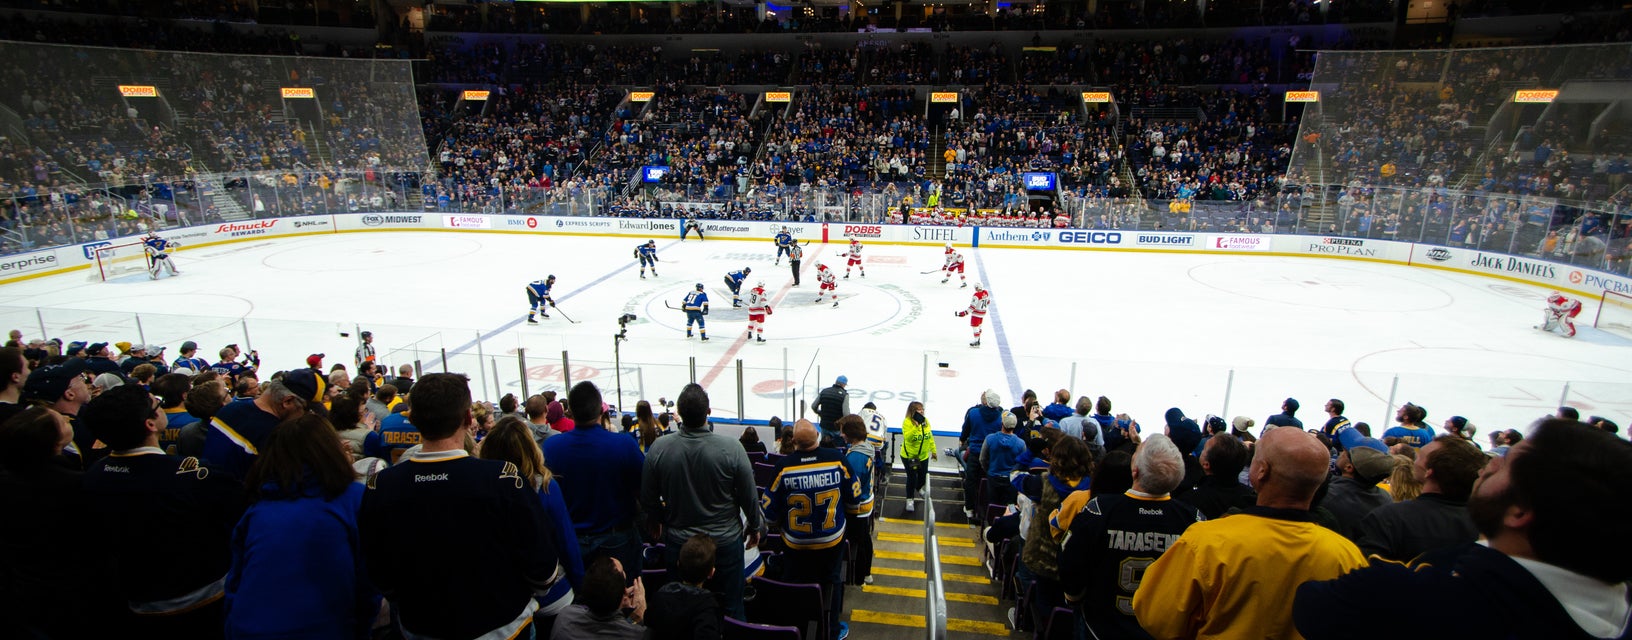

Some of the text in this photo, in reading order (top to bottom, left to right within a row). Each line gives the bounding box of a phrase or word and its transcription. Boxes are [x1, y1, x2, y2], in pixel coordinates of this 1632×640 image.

[385, 215, 422, 223] MIDWEST
[460, 216, 483, 224] FAMOUS
[214, 219, 278, 233] Schnucks
[618, 220, 675, 231] Edward Jones
[706, 224, 750, 232] MOLottery.com
[844, 225, 882, 234] DOBBS
[231, 229, 265, 237] REWARDS
[913, 227, 958, 241] STIFEL
[987, 230, 1029, 242] Anthem
[1058, 231, 1122, 244] GEICO
[1138, 235, 1193, 244] BUD LIGHT
[1229, 237, 1260, 245] FAMOUS
[1330, 238, 1363, 246] PURINA
[1308, 243, 1376, 257] PRO PLAN
[0, 255, 55, 271] erprise
[1471, 252, 1556, 279] JACK DANIEL'S
[687, 295, 697, 304] 91
[870, 414, 882, 432] 5
[383, 431, 422, 445] TARASE
[104, 464, 130, 473] Reebok
[414, 473, 449, 483] Reebok
[784, 470, 841, 490] PIETRANGELO
[852, 481, 861, 498] 2
[786, 487, 841, 534] 27
[1138, 507, 1164, 516] Reebok
[1107, 529, 1181, 553] TARASEN
